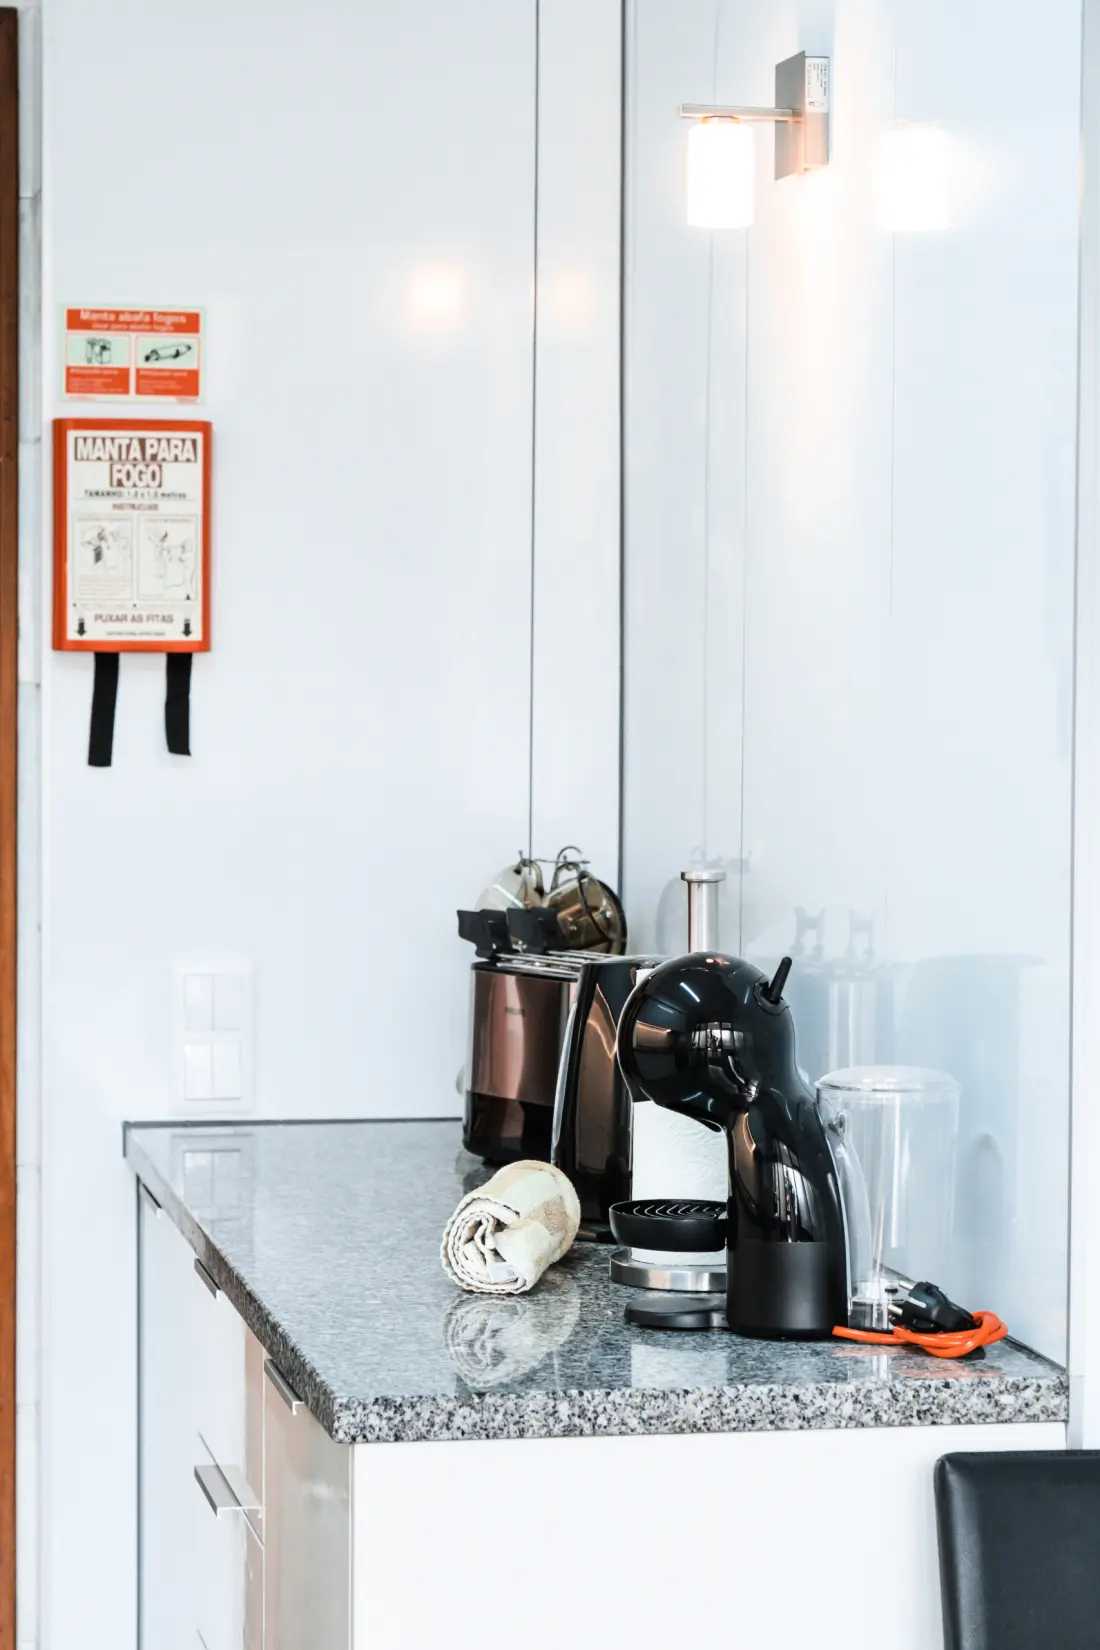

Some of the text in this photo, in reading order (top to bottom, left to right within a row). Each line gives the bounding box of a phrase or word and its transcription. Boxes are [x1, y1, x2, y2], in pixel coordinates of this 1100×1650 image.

[80, 309, 115, 321] Manta
[77, 437, 195, 462] MANTA PARA
[112, 463, 161, 488] FOGO
[94, 614, 174, 624] PUXAR AS FITAS
